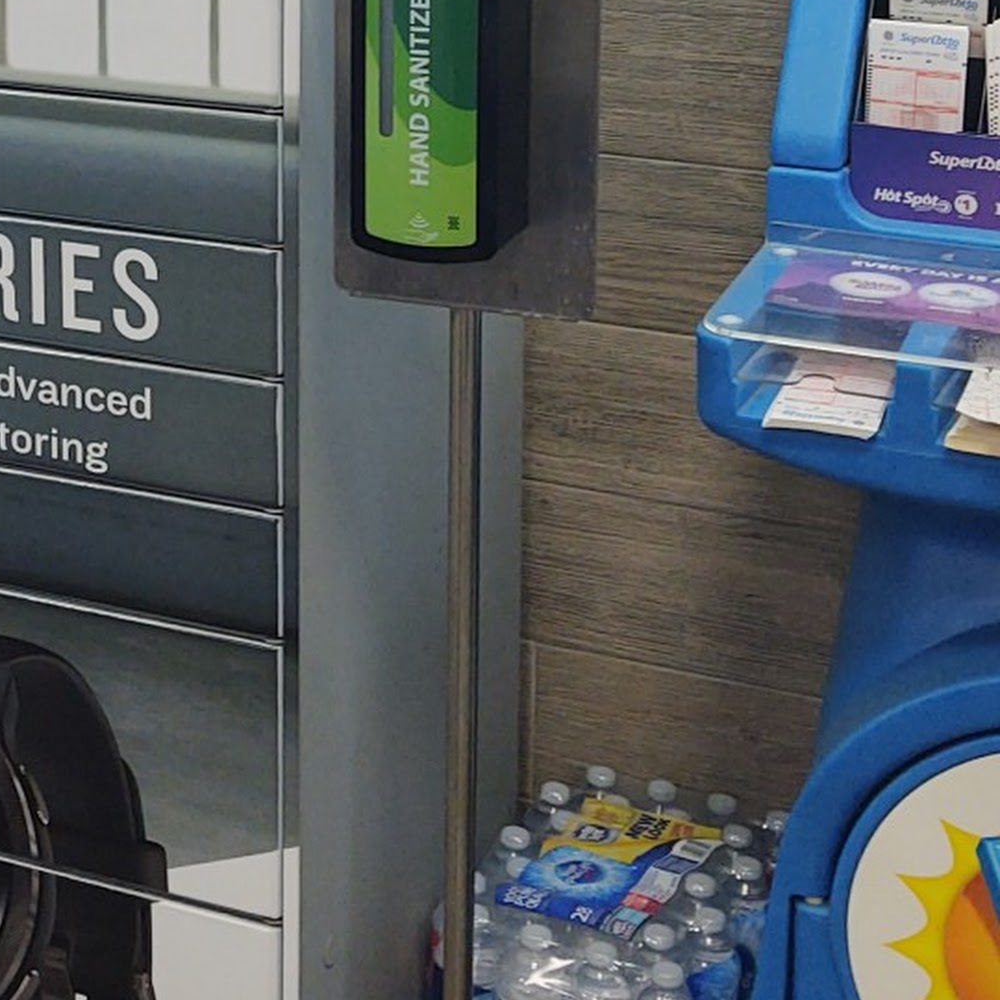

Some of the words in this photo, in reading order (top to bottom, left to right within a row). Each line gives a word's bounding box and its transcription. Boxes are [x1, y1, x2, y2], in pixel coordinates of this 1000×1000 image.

[409, 112, 430, 187] HAND
[873, 187, 902, 203] Hot
[903, 190, 941, 209] Spot
